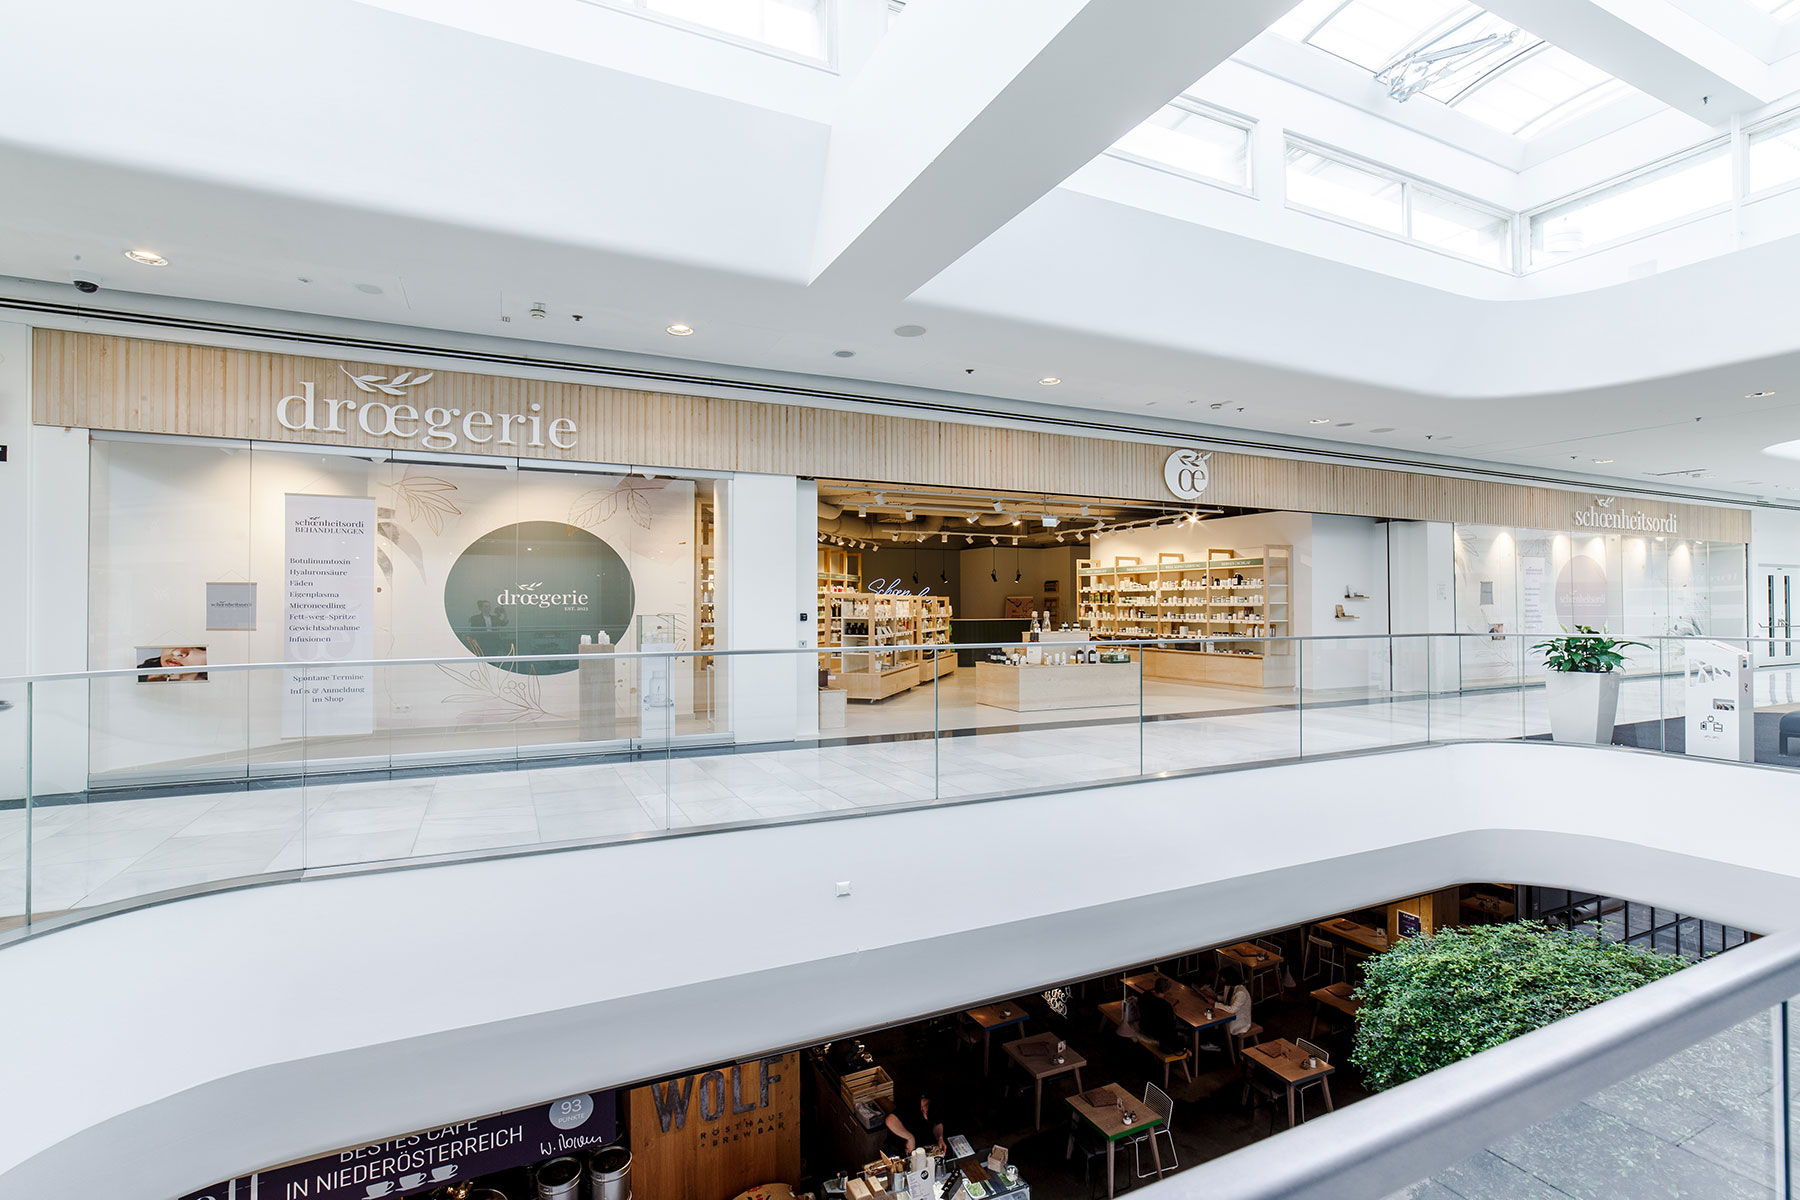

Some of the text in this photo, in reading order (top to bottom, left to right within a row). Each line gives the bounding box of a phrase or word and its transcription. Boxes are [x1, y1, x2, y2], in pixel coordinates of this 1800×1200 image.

[295, 527, 364, 535] BEHANDLUNGEN
[290, 557, 351, 565] Botulinumtoxin
[289, 569, 348, 577] Hyaluronsäure
[289, 591, 340, 599] Eigenplasma
[651, 1055, 784, 1133] WOLF
[561, 1099, 582, 1115] 93
[558, 1112, 586, 1124] PUNKTE
[700, 1111, 784, 1140] RÖSTHAUS
[712, 1122, 785, 1147] BREWBAR
[286, 1178, 308, 1200] IN
[316, 1124, 523, 1194] NIEDERÖSTERREICH
